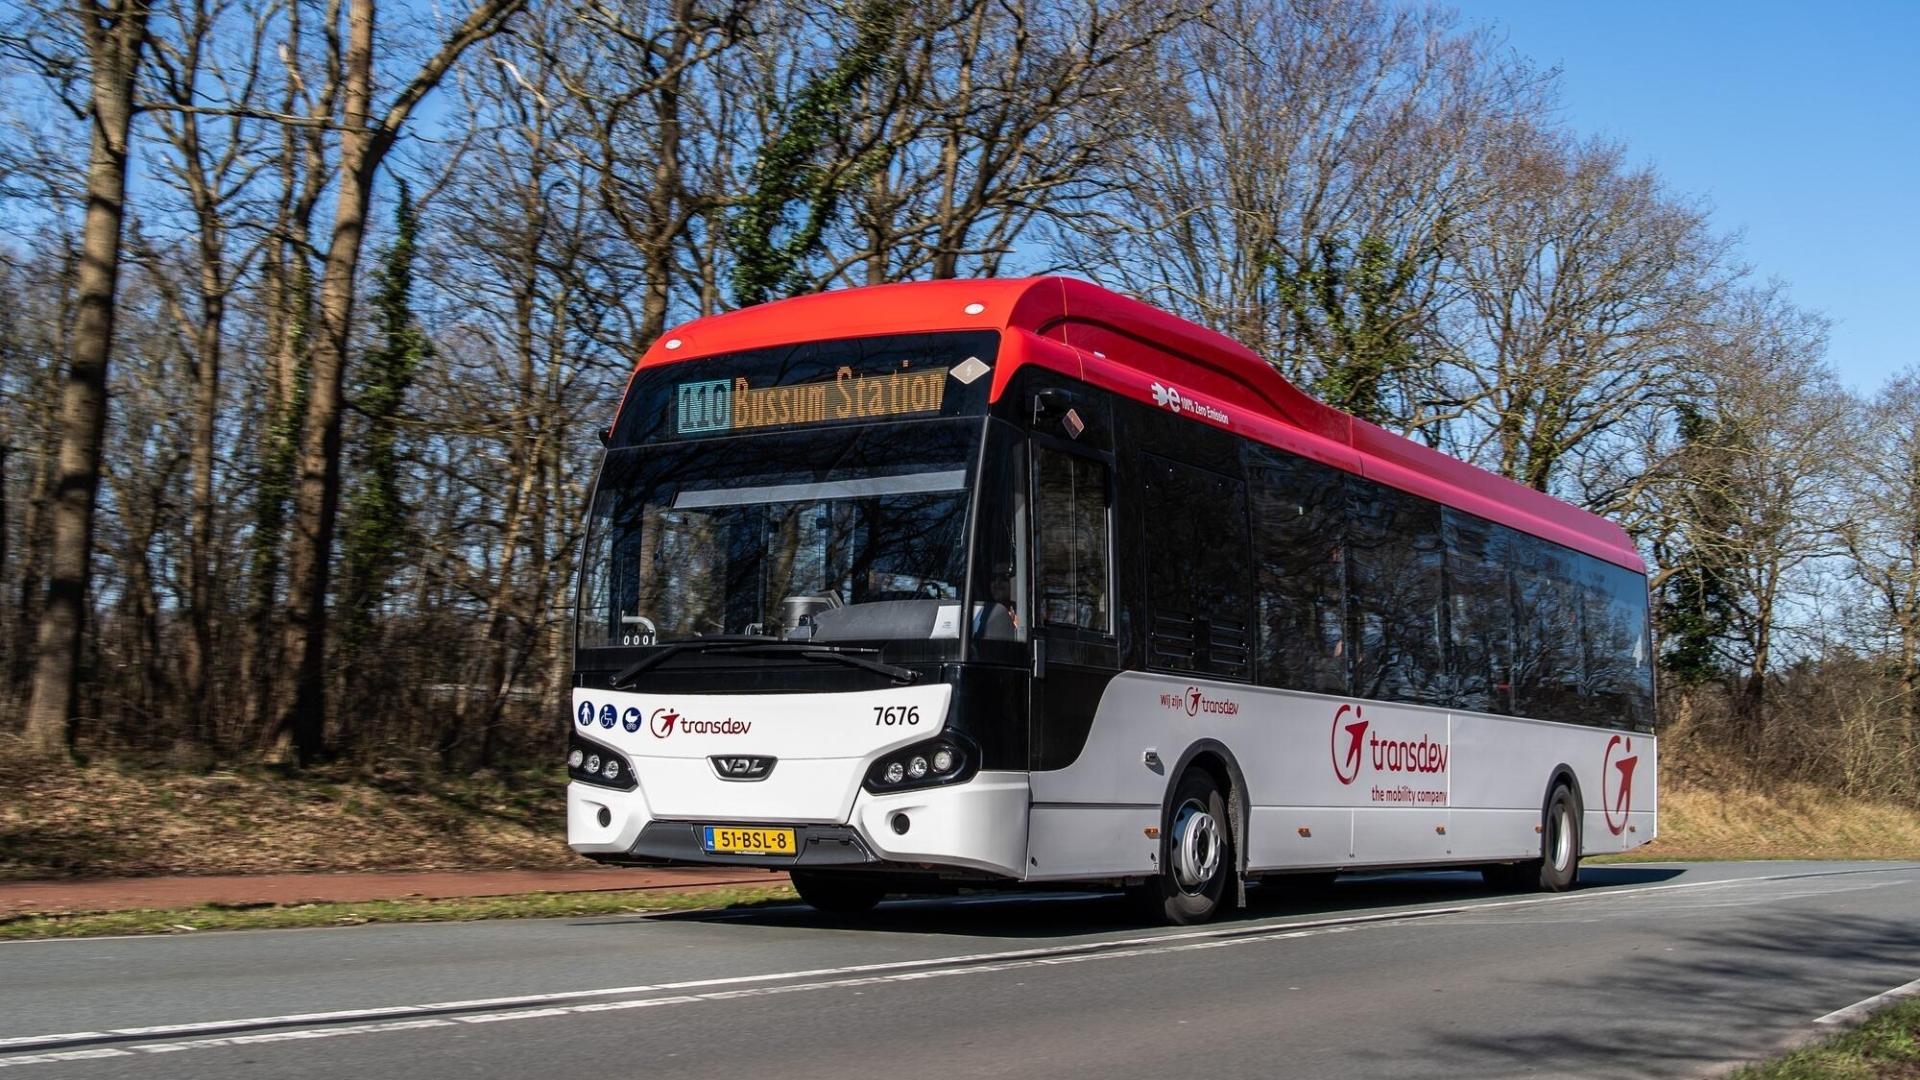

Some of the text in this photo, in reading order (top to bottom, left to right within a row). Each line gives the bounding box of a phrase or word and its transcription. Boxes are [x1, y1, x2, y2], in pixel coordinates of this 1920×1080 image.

[682, 359, 943, 428] 110 Bussum Station
[1195, 401, 1206, 416] Zero
[1206, 406, 1229, 424] Emission
[1160, 695, 1239, 715] Wij zijn transdev
[681, 717, 751, 735] transdev
[874, 706, 919, 726] 7676
[1370, 731, 1448, 773] transdev
[718, 759, 764, 773] VDL
[1372, 785, 1447, 806] the mobility company
[721, 831, 787, 849] 51-BSL-8
